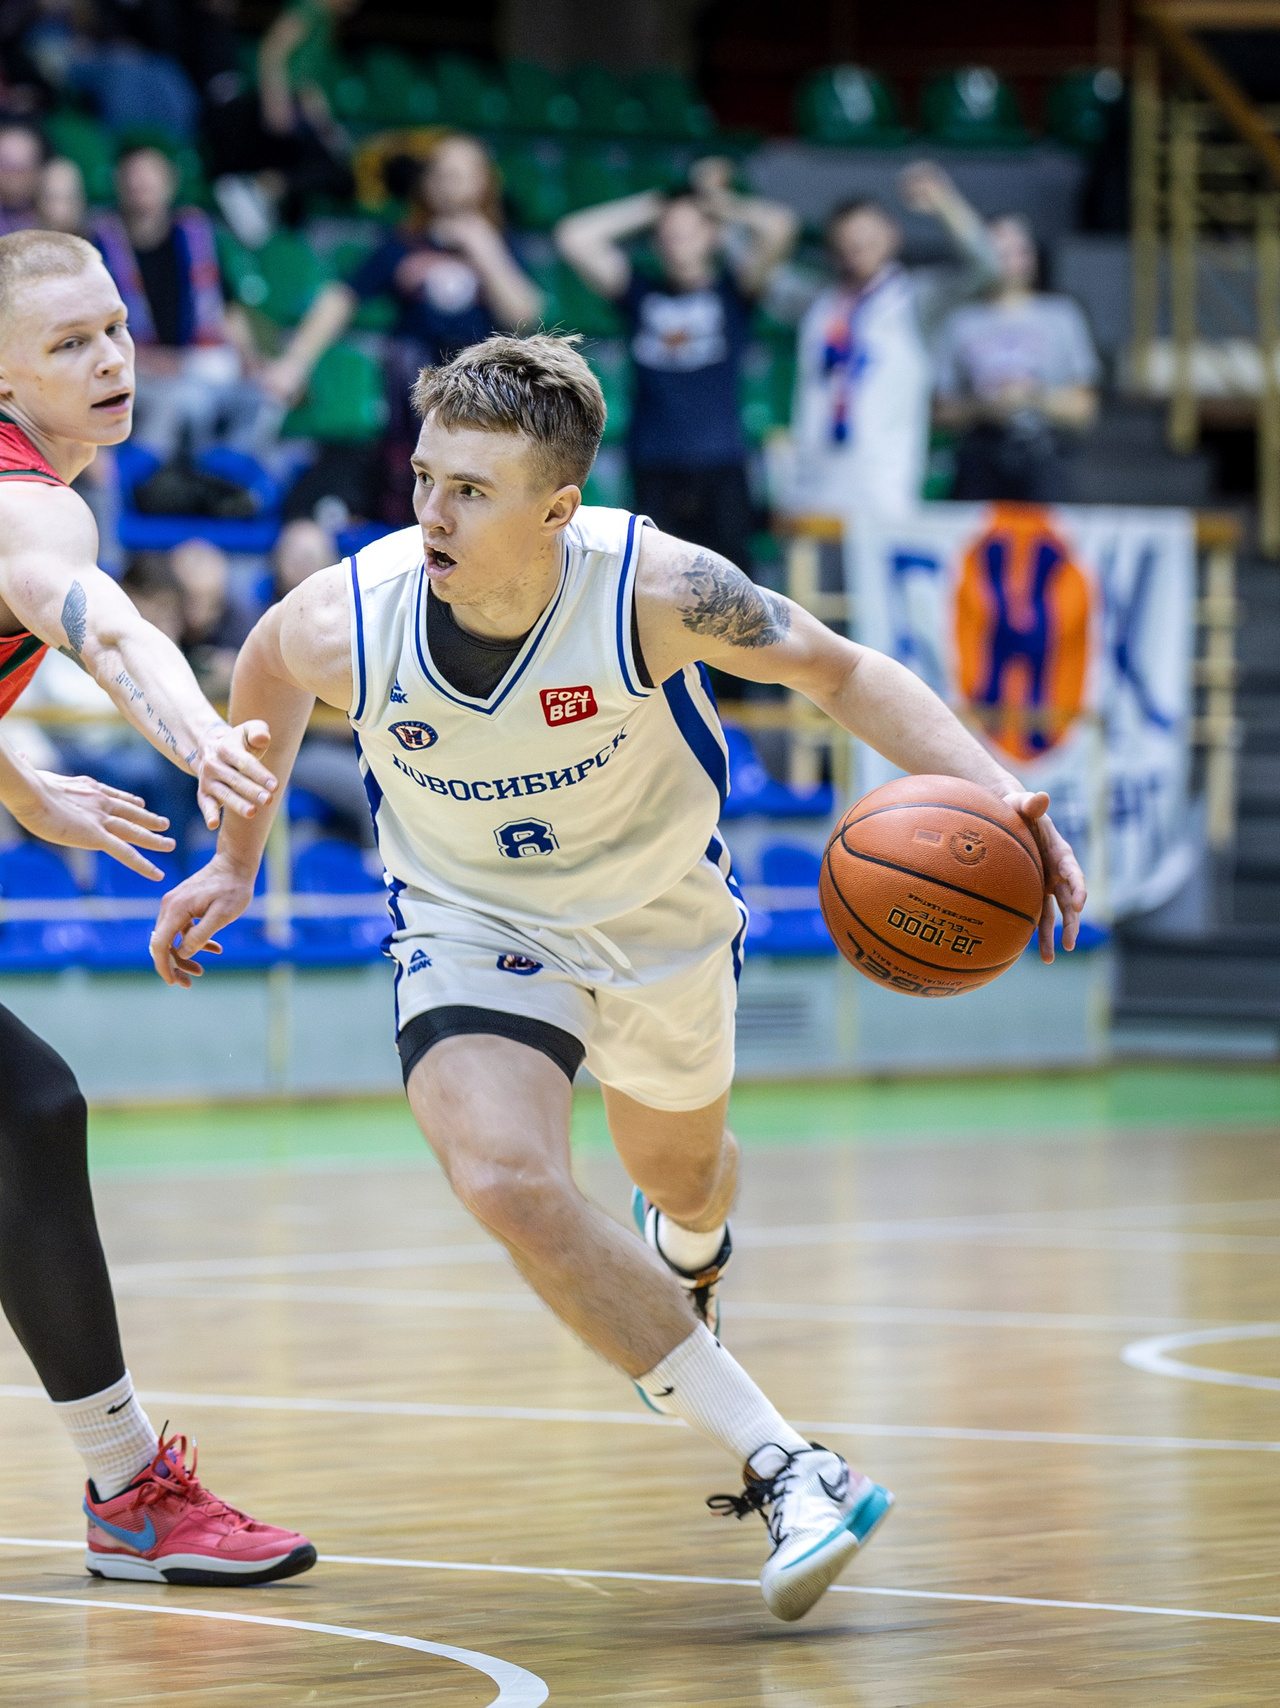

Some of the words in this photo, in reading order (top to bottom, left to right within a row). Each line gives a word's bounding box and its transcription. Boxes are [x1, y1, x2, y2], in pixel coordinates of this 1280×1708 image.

[390, 687, 409, 704] EAK
[545, 690, 589, 706] FON
[549, 698, 592, 722] BET
[392, 723, 628, 801] НОВОСИБИРСК
[493, 817, 560, 859] 8
[887, 907, 983, 956] JB-1000
[918, 911, 965, 933] ELITE
